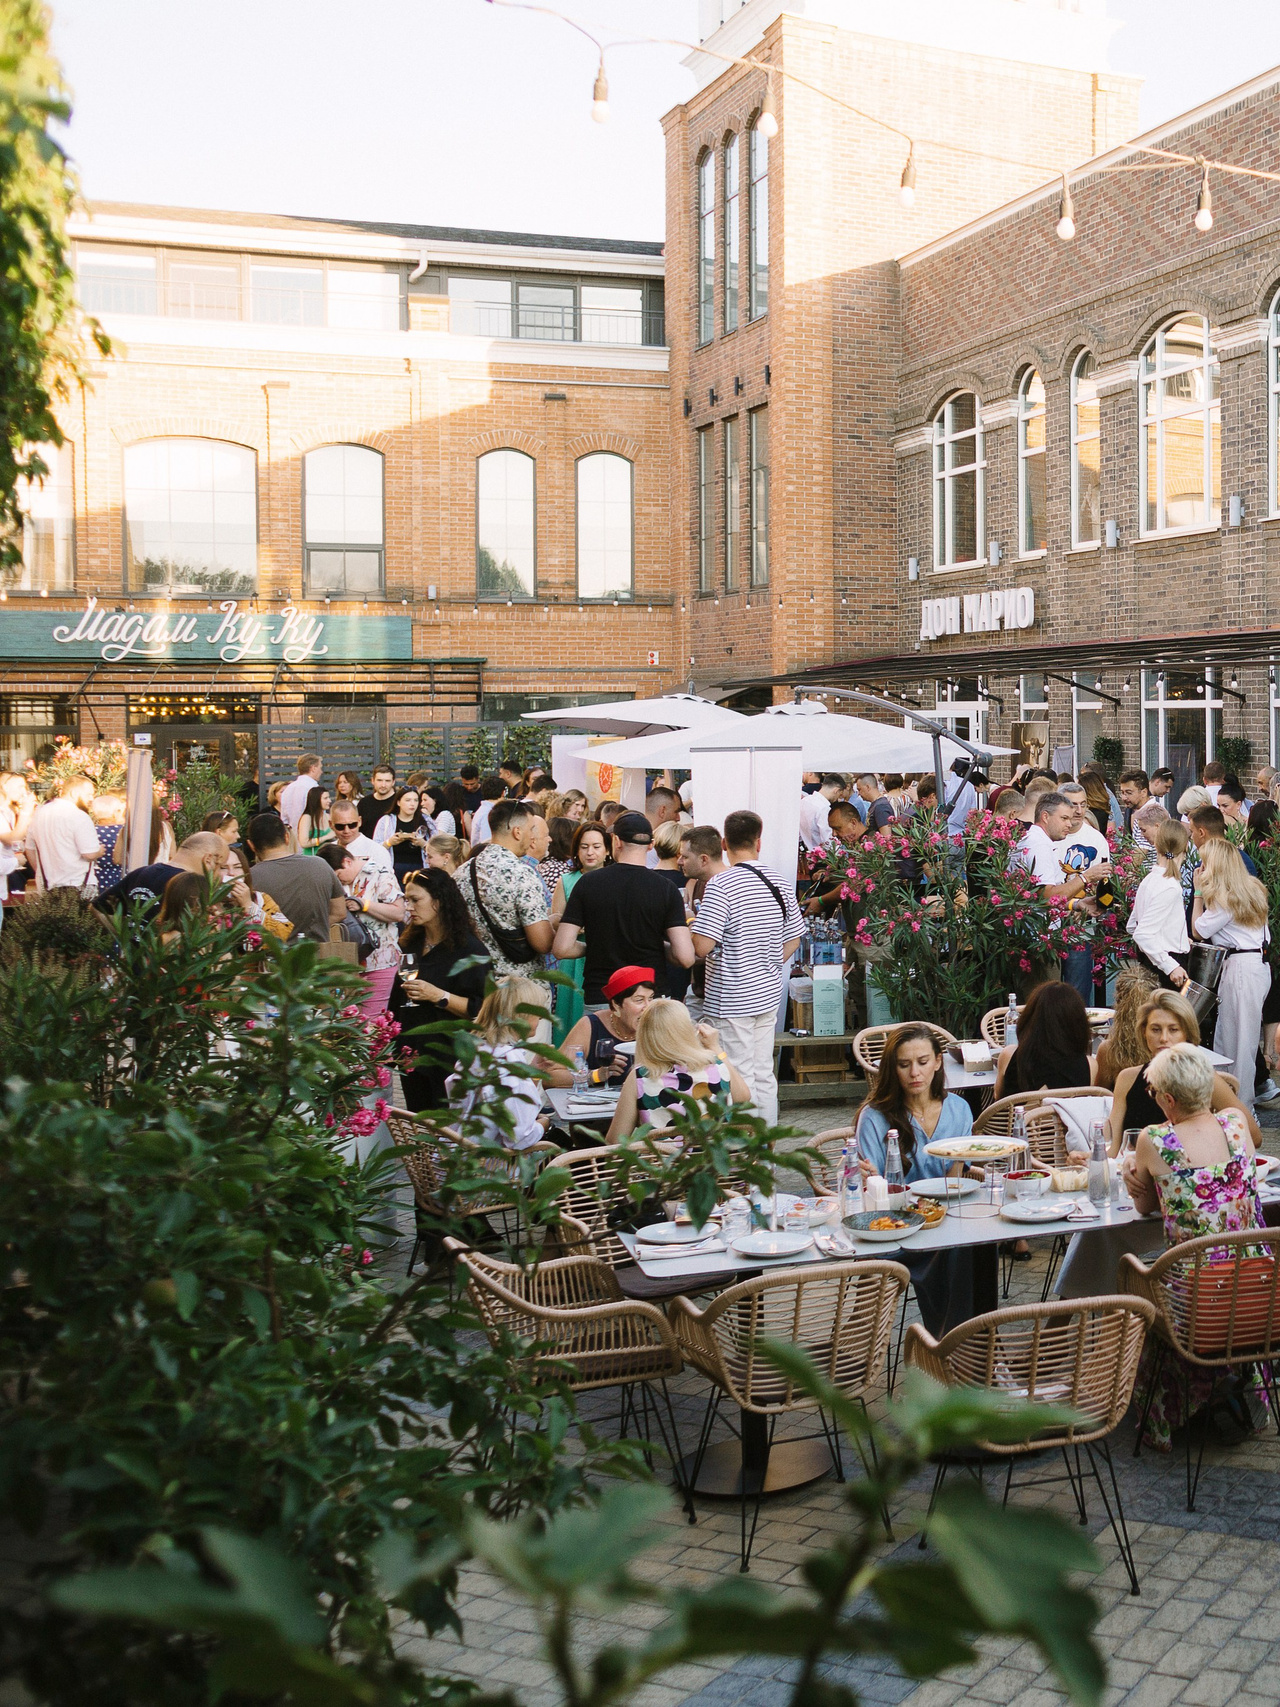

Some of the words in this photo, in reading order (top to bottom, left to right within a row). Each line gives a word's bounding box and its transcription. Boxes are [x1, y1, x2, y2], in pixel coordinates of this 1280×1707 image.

[52, 596, 199, 662] Мадам
[206, 600, 329, 663] Ку-Ку
[920, 596, 961, 641] ДОН
[963, 587, 1035, 634] МАРИО
